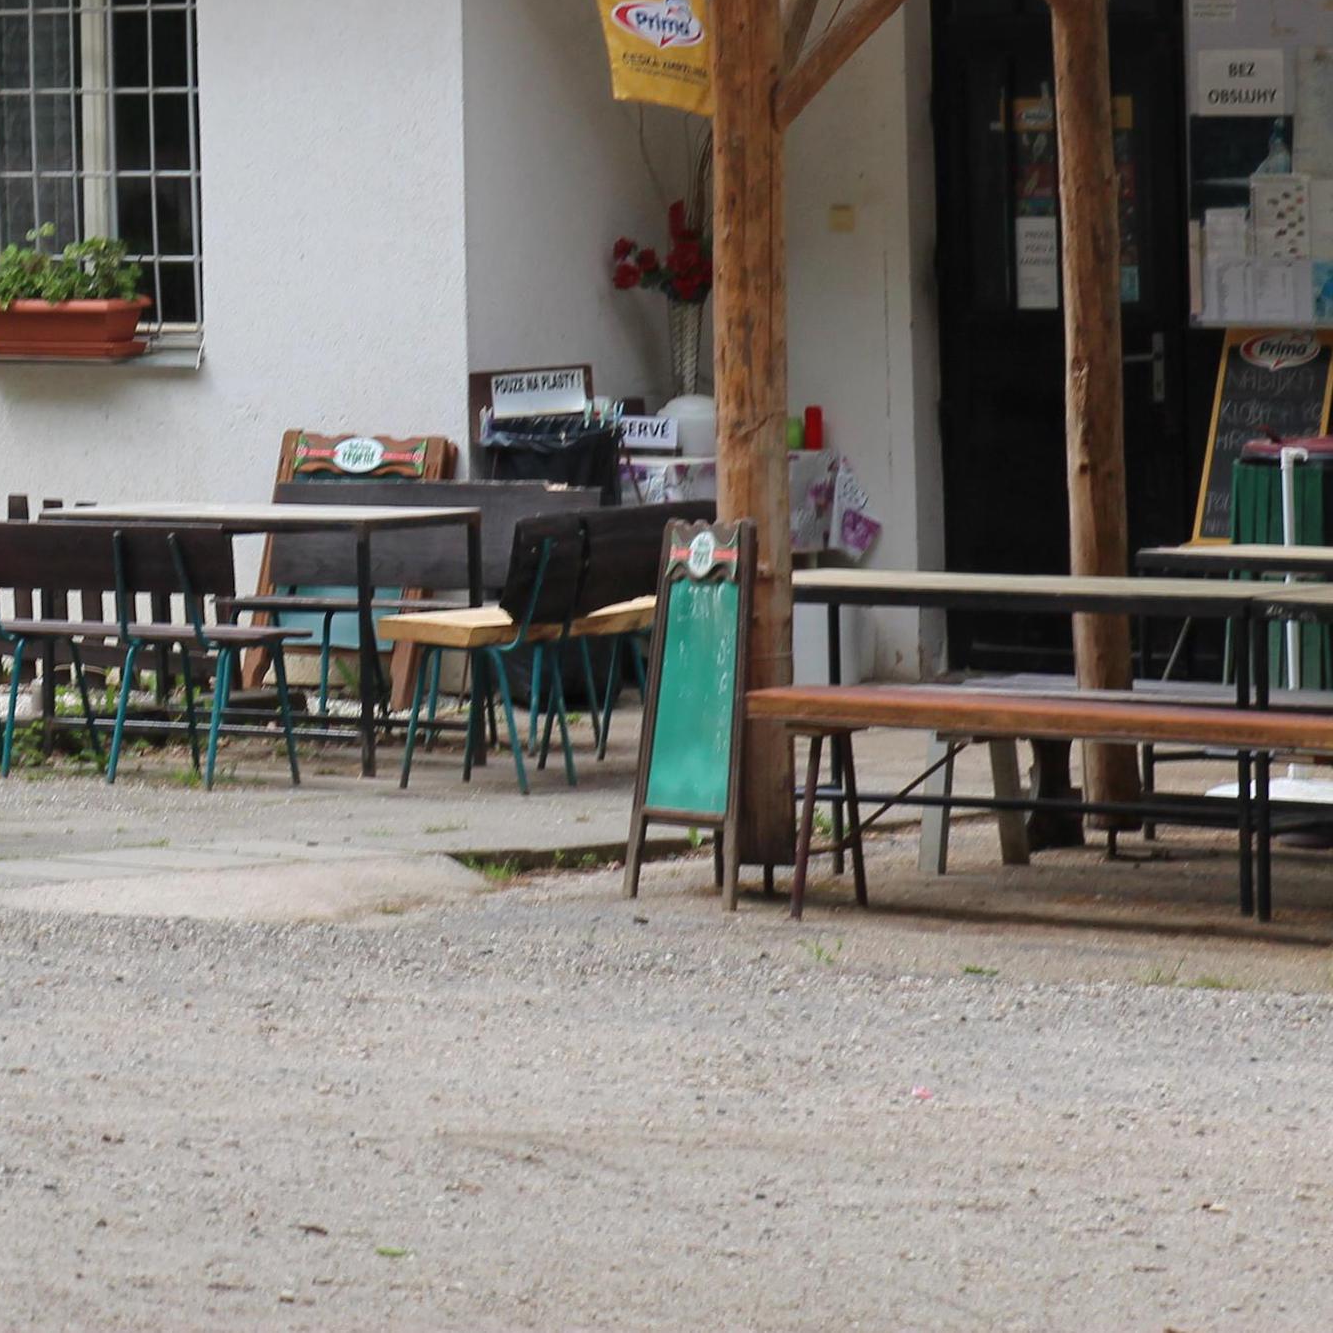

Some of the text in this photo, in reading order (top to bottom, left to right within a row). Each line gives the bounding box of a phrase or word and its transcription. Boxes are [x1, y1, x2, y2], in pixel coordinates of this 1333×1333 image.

[1228, 62, 1255, 78] BEZ
[1208, 88, 1277, 105] OBSLUHY
[1258, 340, 1308, 357] Prima
[494, 377, 524, 395] POUZE
[526, 375, 539, 392] NA
[621, 418, 671, 439] SERVÉ
